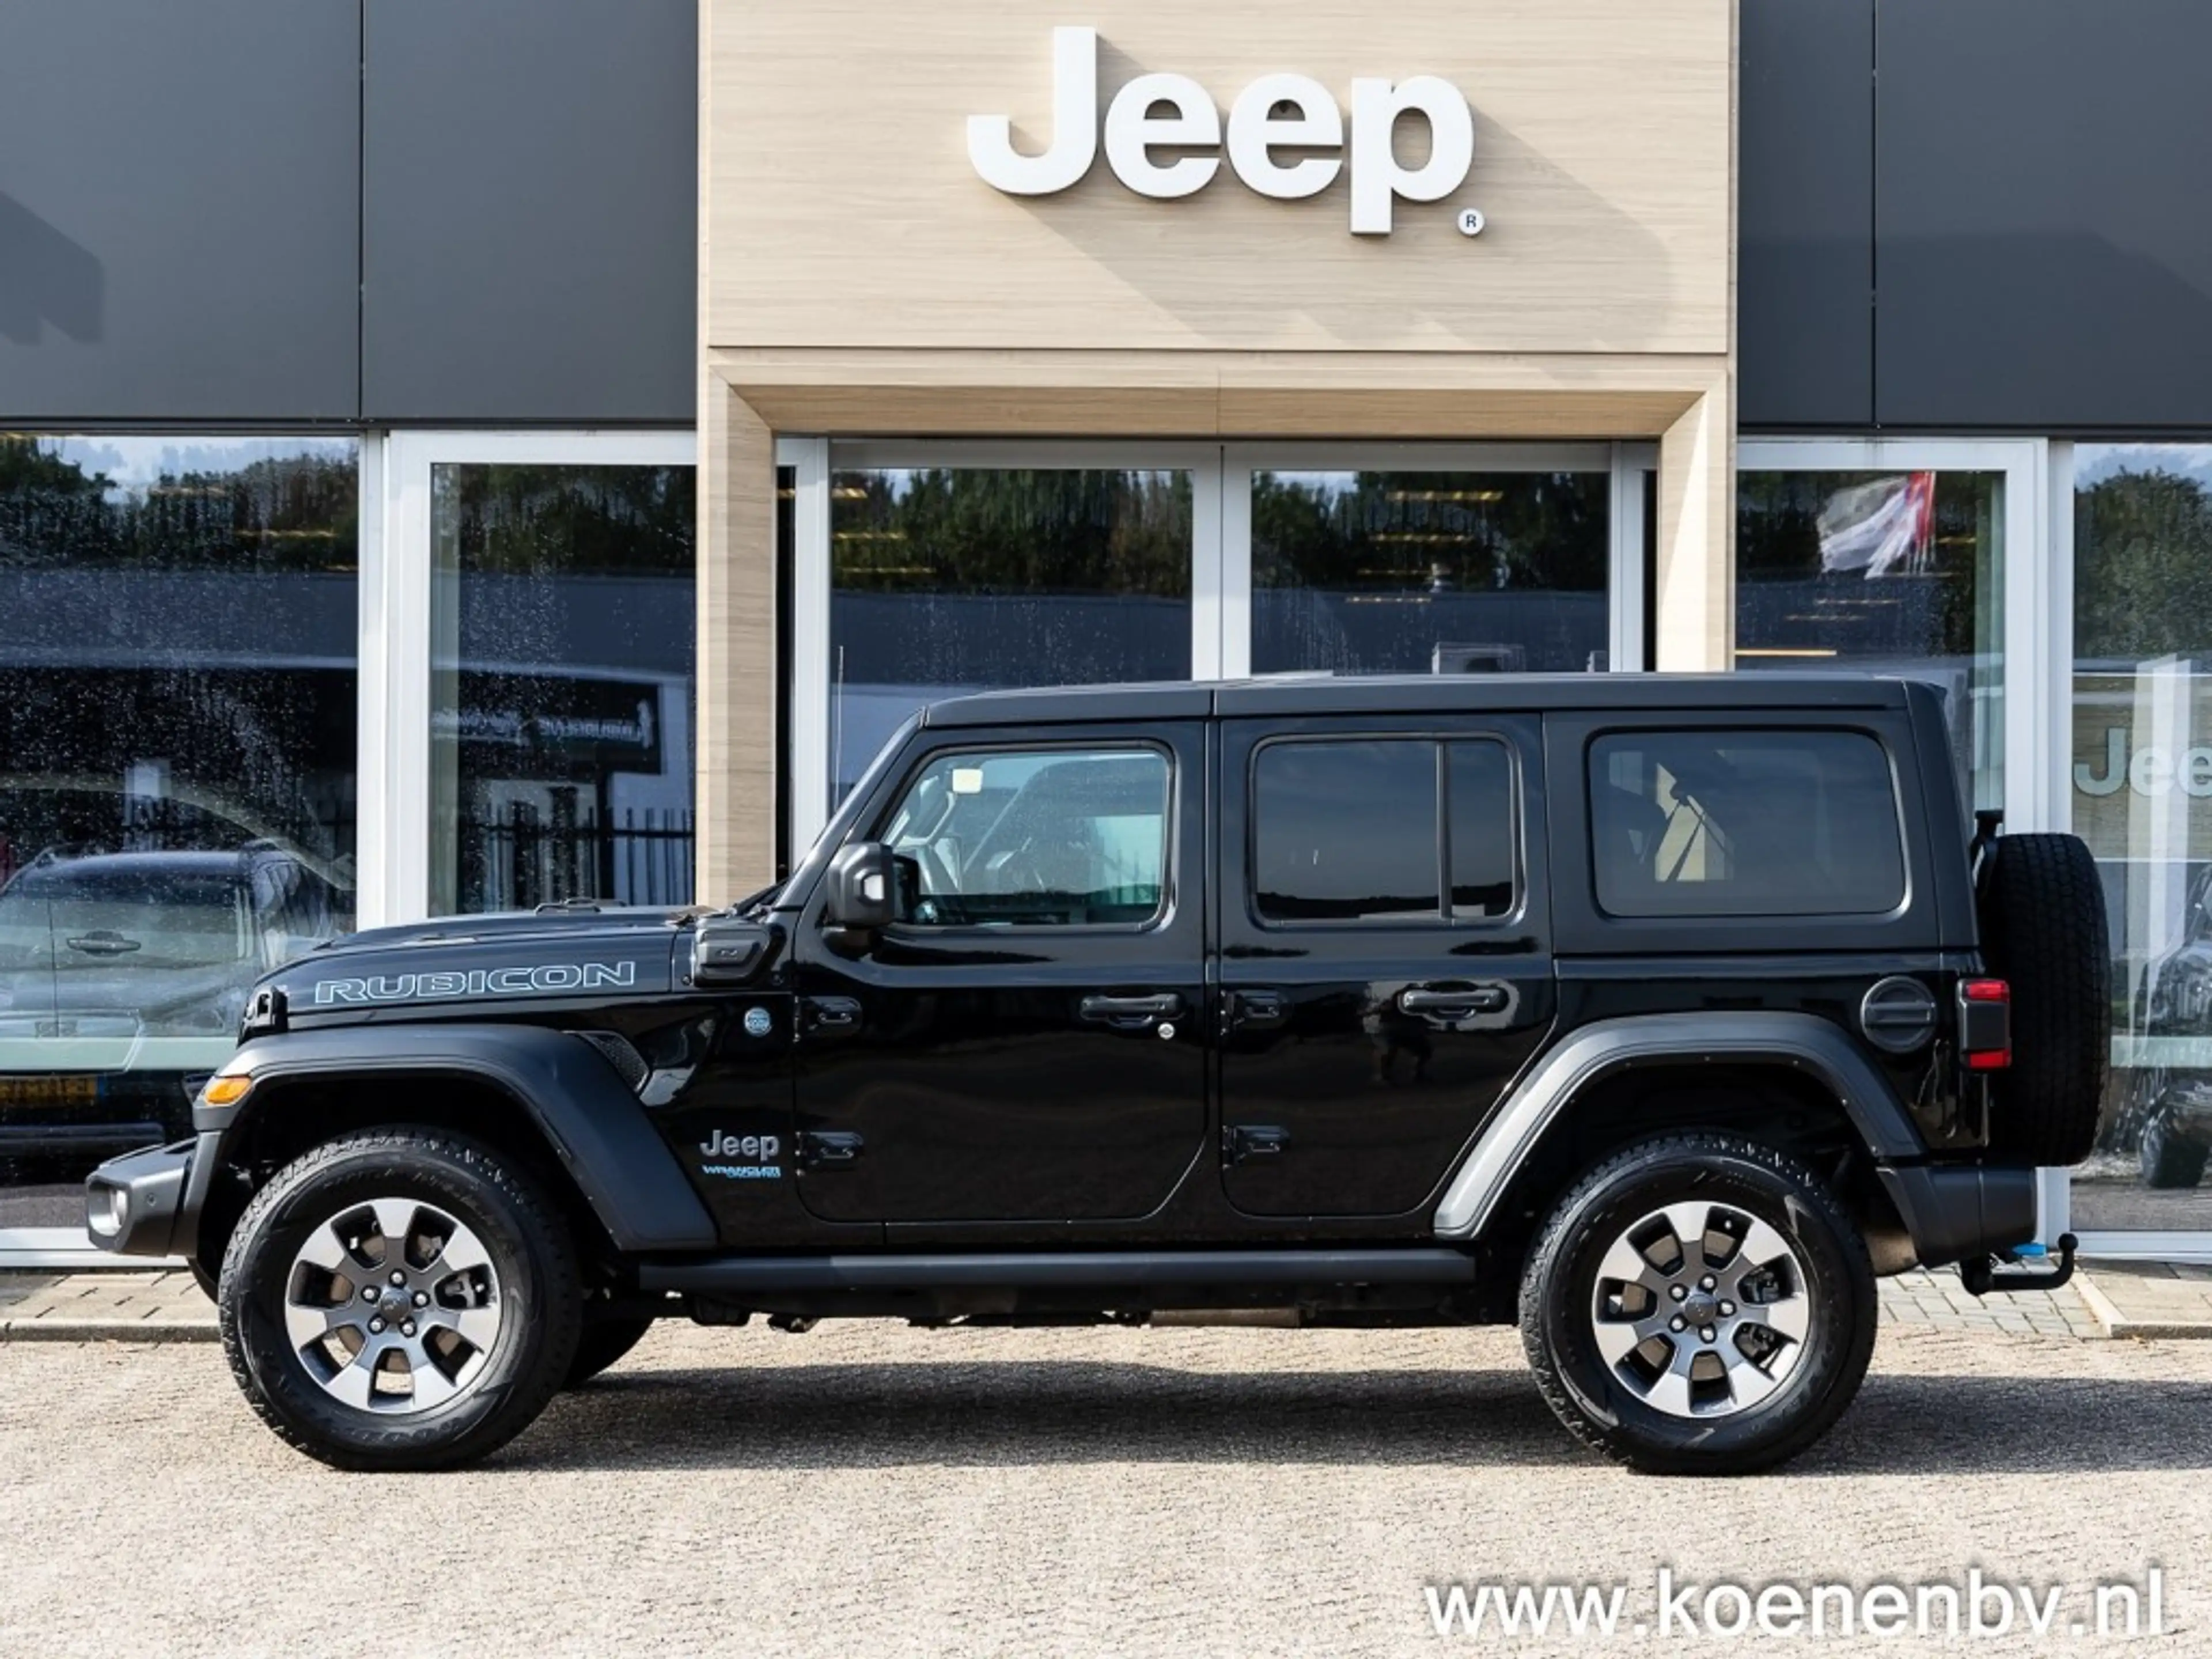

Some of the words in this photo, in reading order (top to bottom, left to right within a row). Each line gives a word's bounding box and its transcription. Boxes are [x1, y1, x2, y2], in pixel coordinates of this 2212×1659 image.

[967, 26, 1474, 234] Jeep
[315, 961, 635, 1004] RUBICON
[699, 1130, 780, 1161] Jeep
